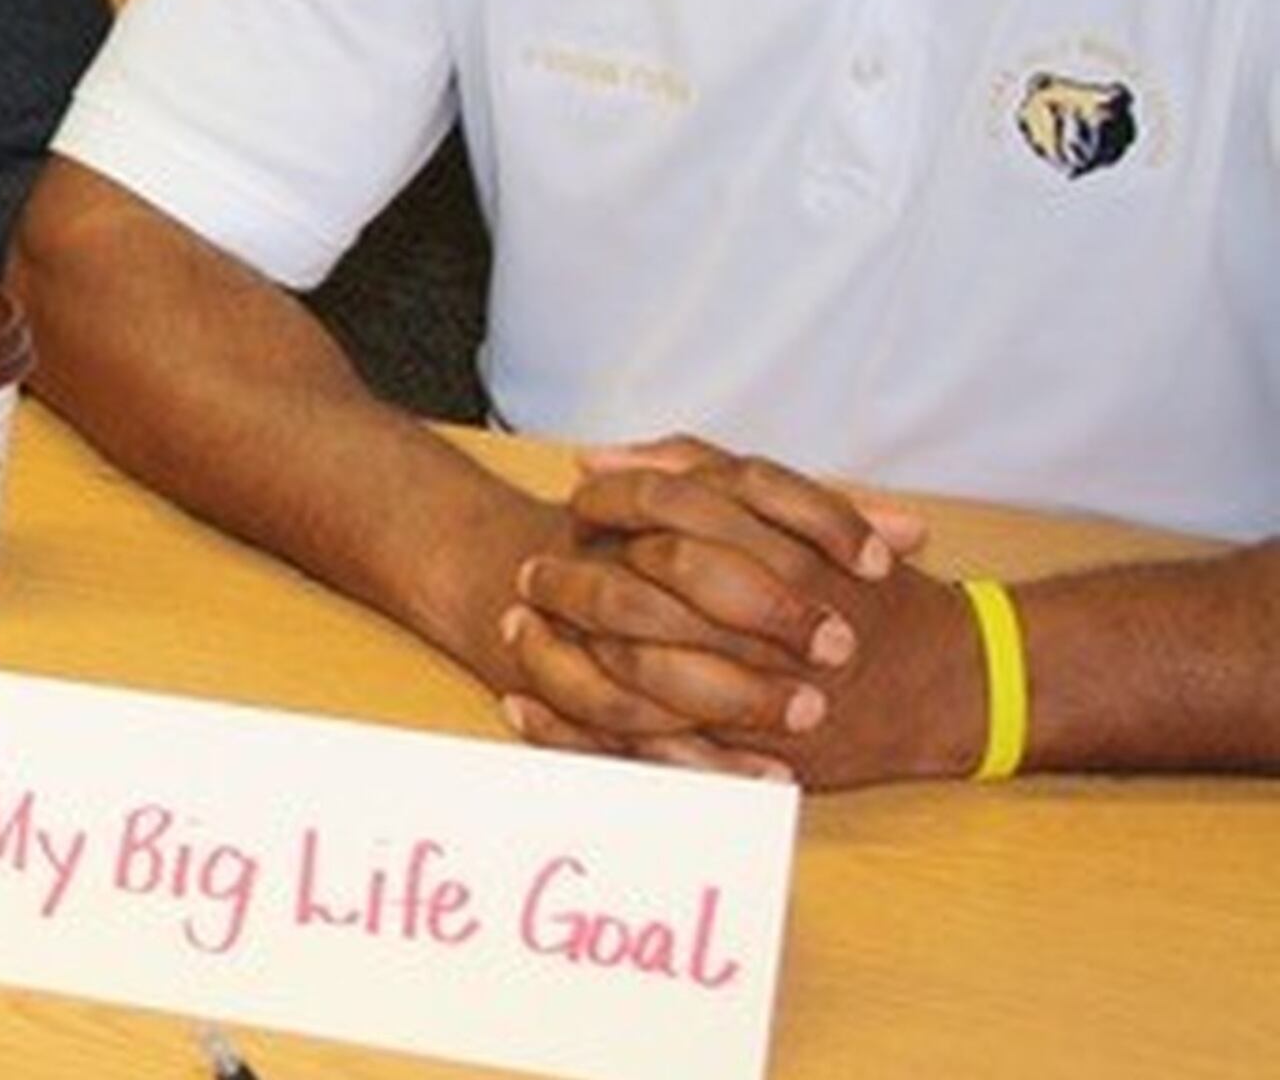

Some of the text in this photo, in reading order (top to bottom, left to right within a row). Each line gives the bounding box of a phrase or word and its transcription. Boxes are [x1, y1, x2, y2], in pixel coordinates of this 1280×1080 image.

[113, 803, 259, 955] Big
[295, 828, 482, 946] Life
[518, 857, 742, 988] Goal
